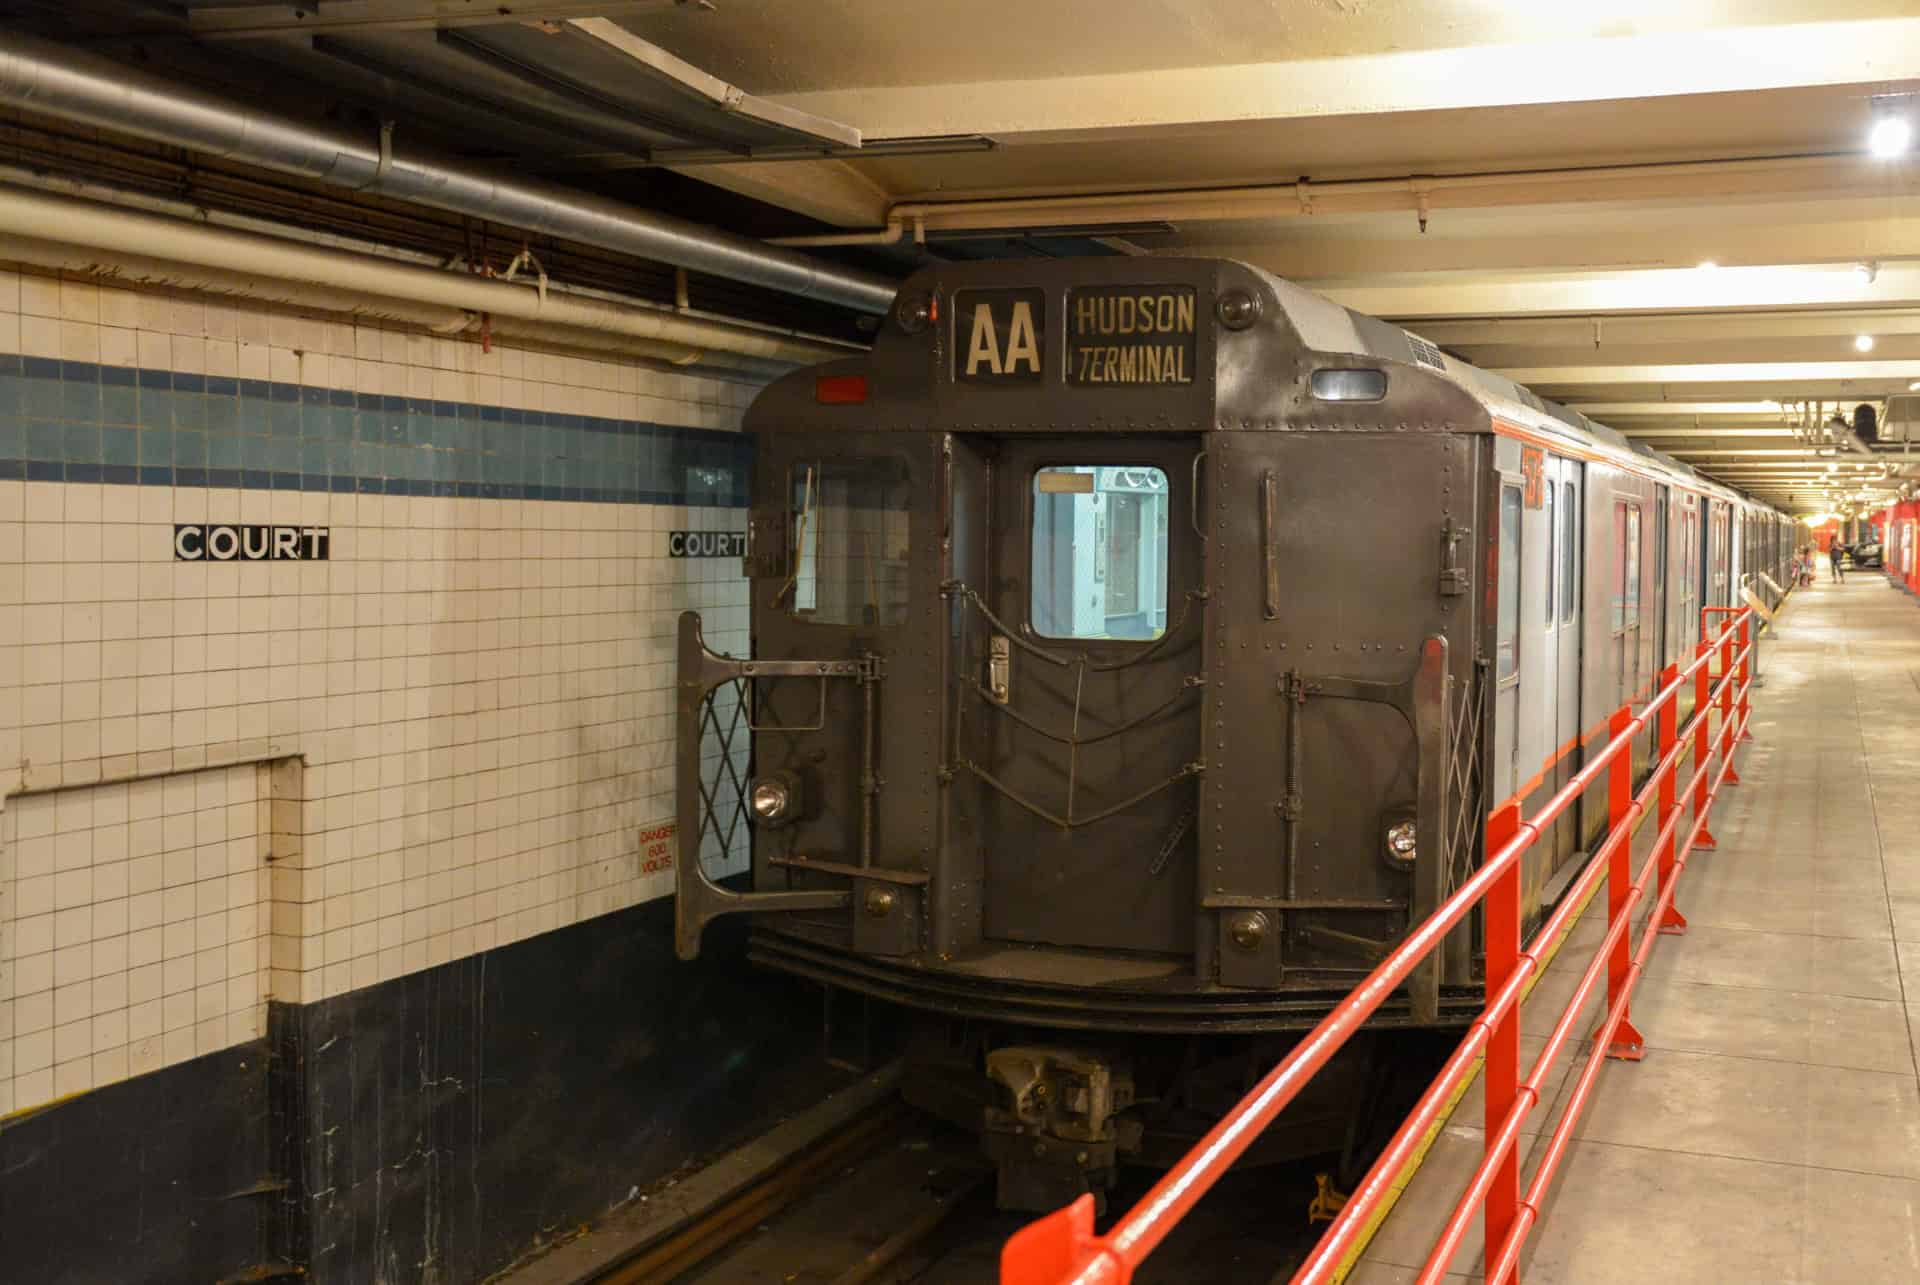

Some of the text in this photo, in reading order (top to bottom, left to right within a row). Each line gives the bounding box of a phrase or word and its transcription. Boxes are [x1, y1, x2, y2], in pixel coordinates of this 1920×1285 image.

[1077, 295, 1194, 334] HUDSON
[966, 301, 1041, 376] AA
[1079, 345, 1191, 383] TERMINAL
[175, 526, 328, 560] COURT
[670, 532, 744, 556] COURT
